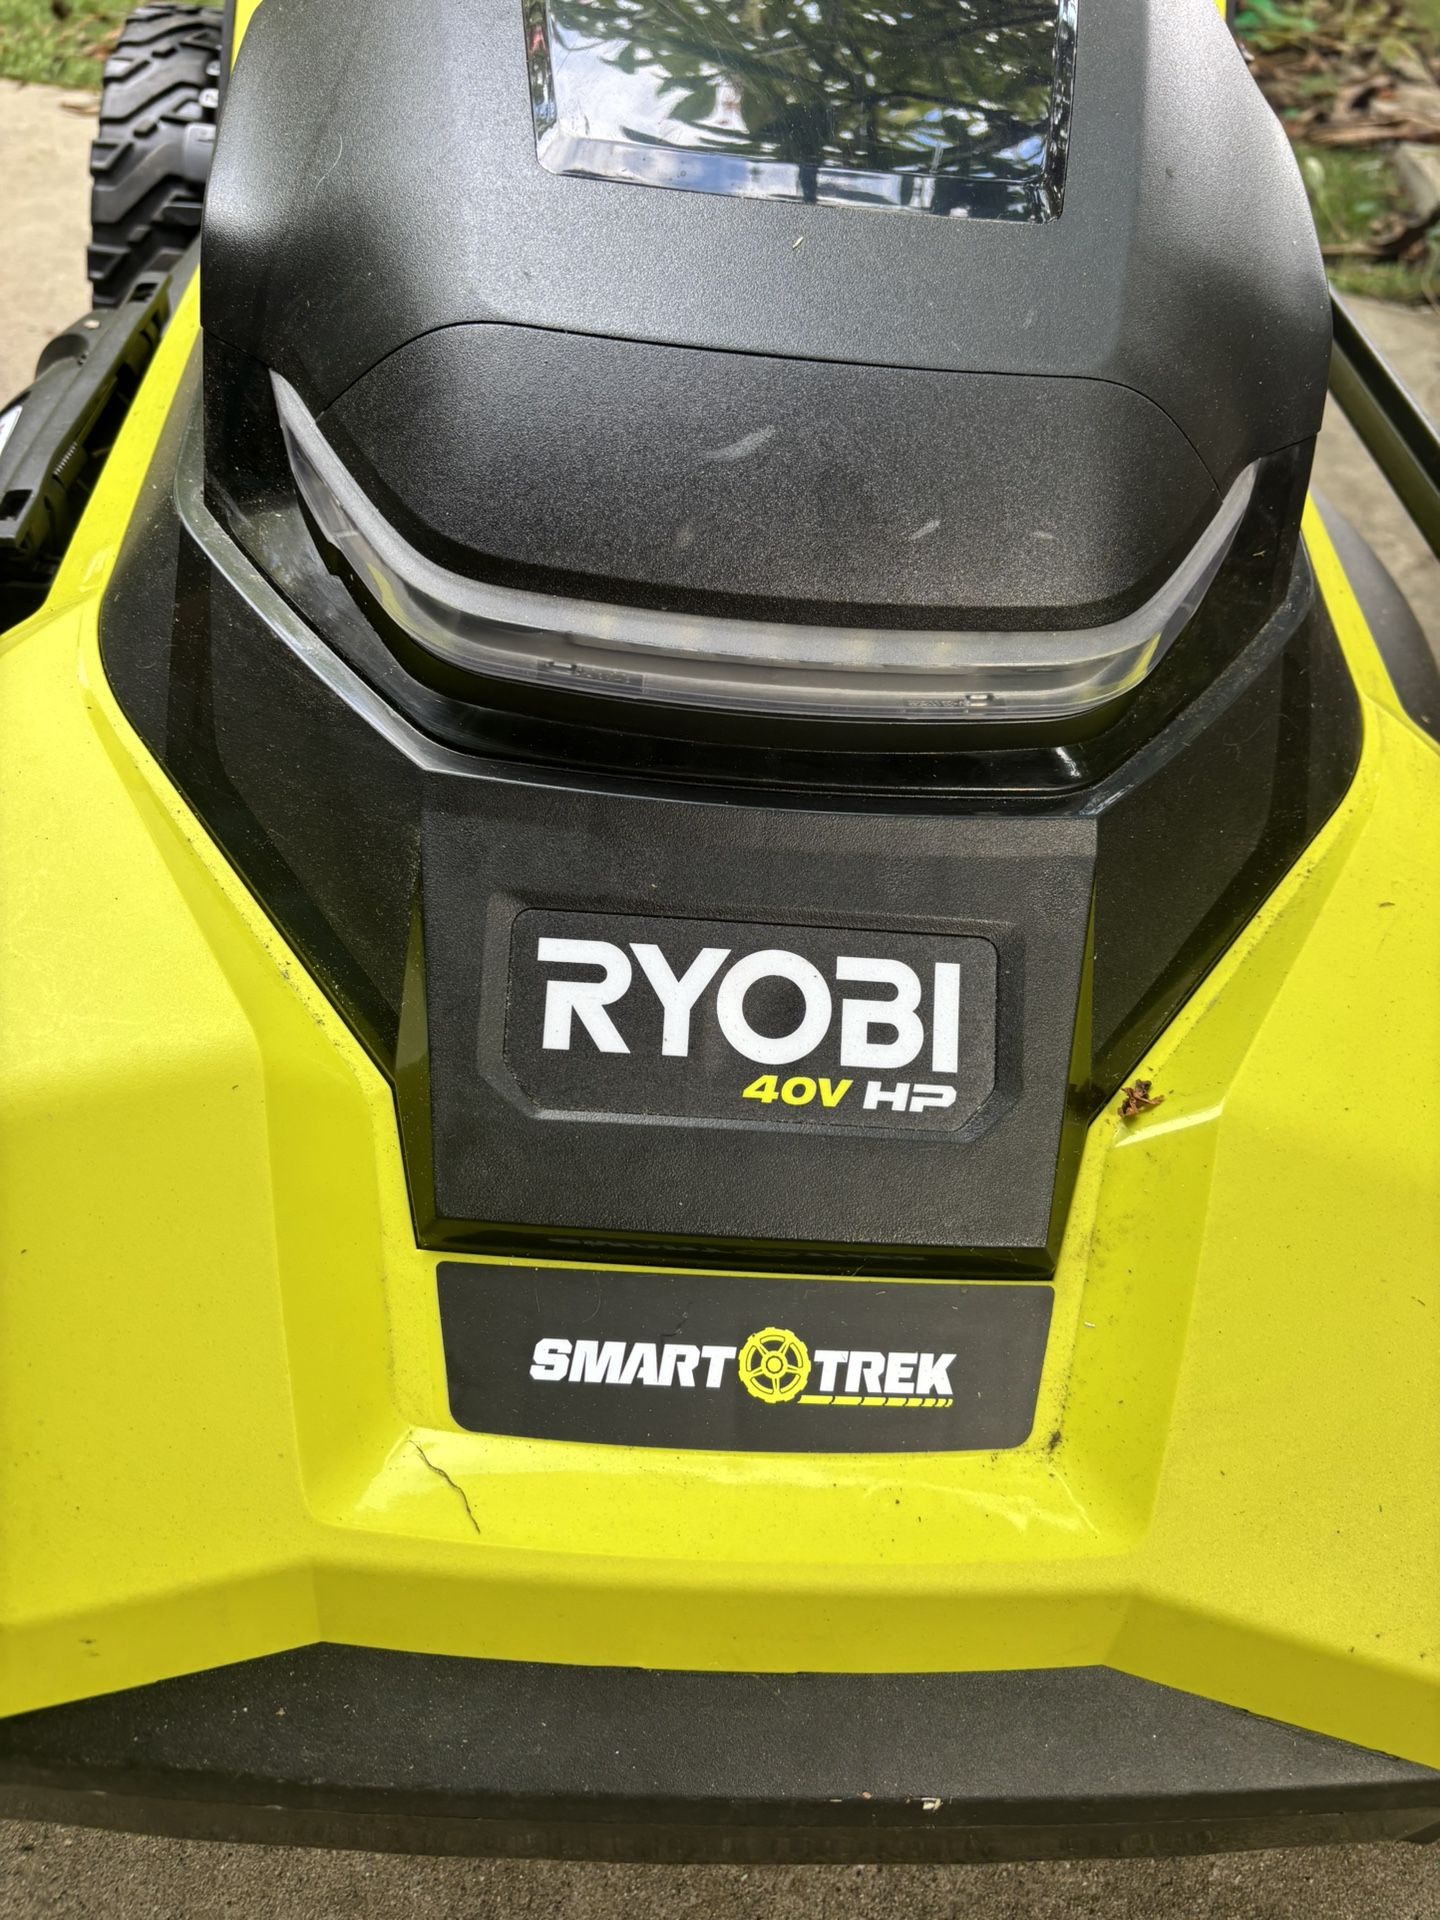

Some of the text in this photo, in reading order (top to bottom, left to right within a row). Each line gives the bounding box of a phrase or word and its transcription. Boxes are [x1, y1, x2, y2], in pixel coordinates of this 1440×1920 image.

[538, 937, 960, 1073] RYOBI
[742, 1074, 957, 1112] 40V HP
[530, 1338, 957, 1394] SMART TREK
